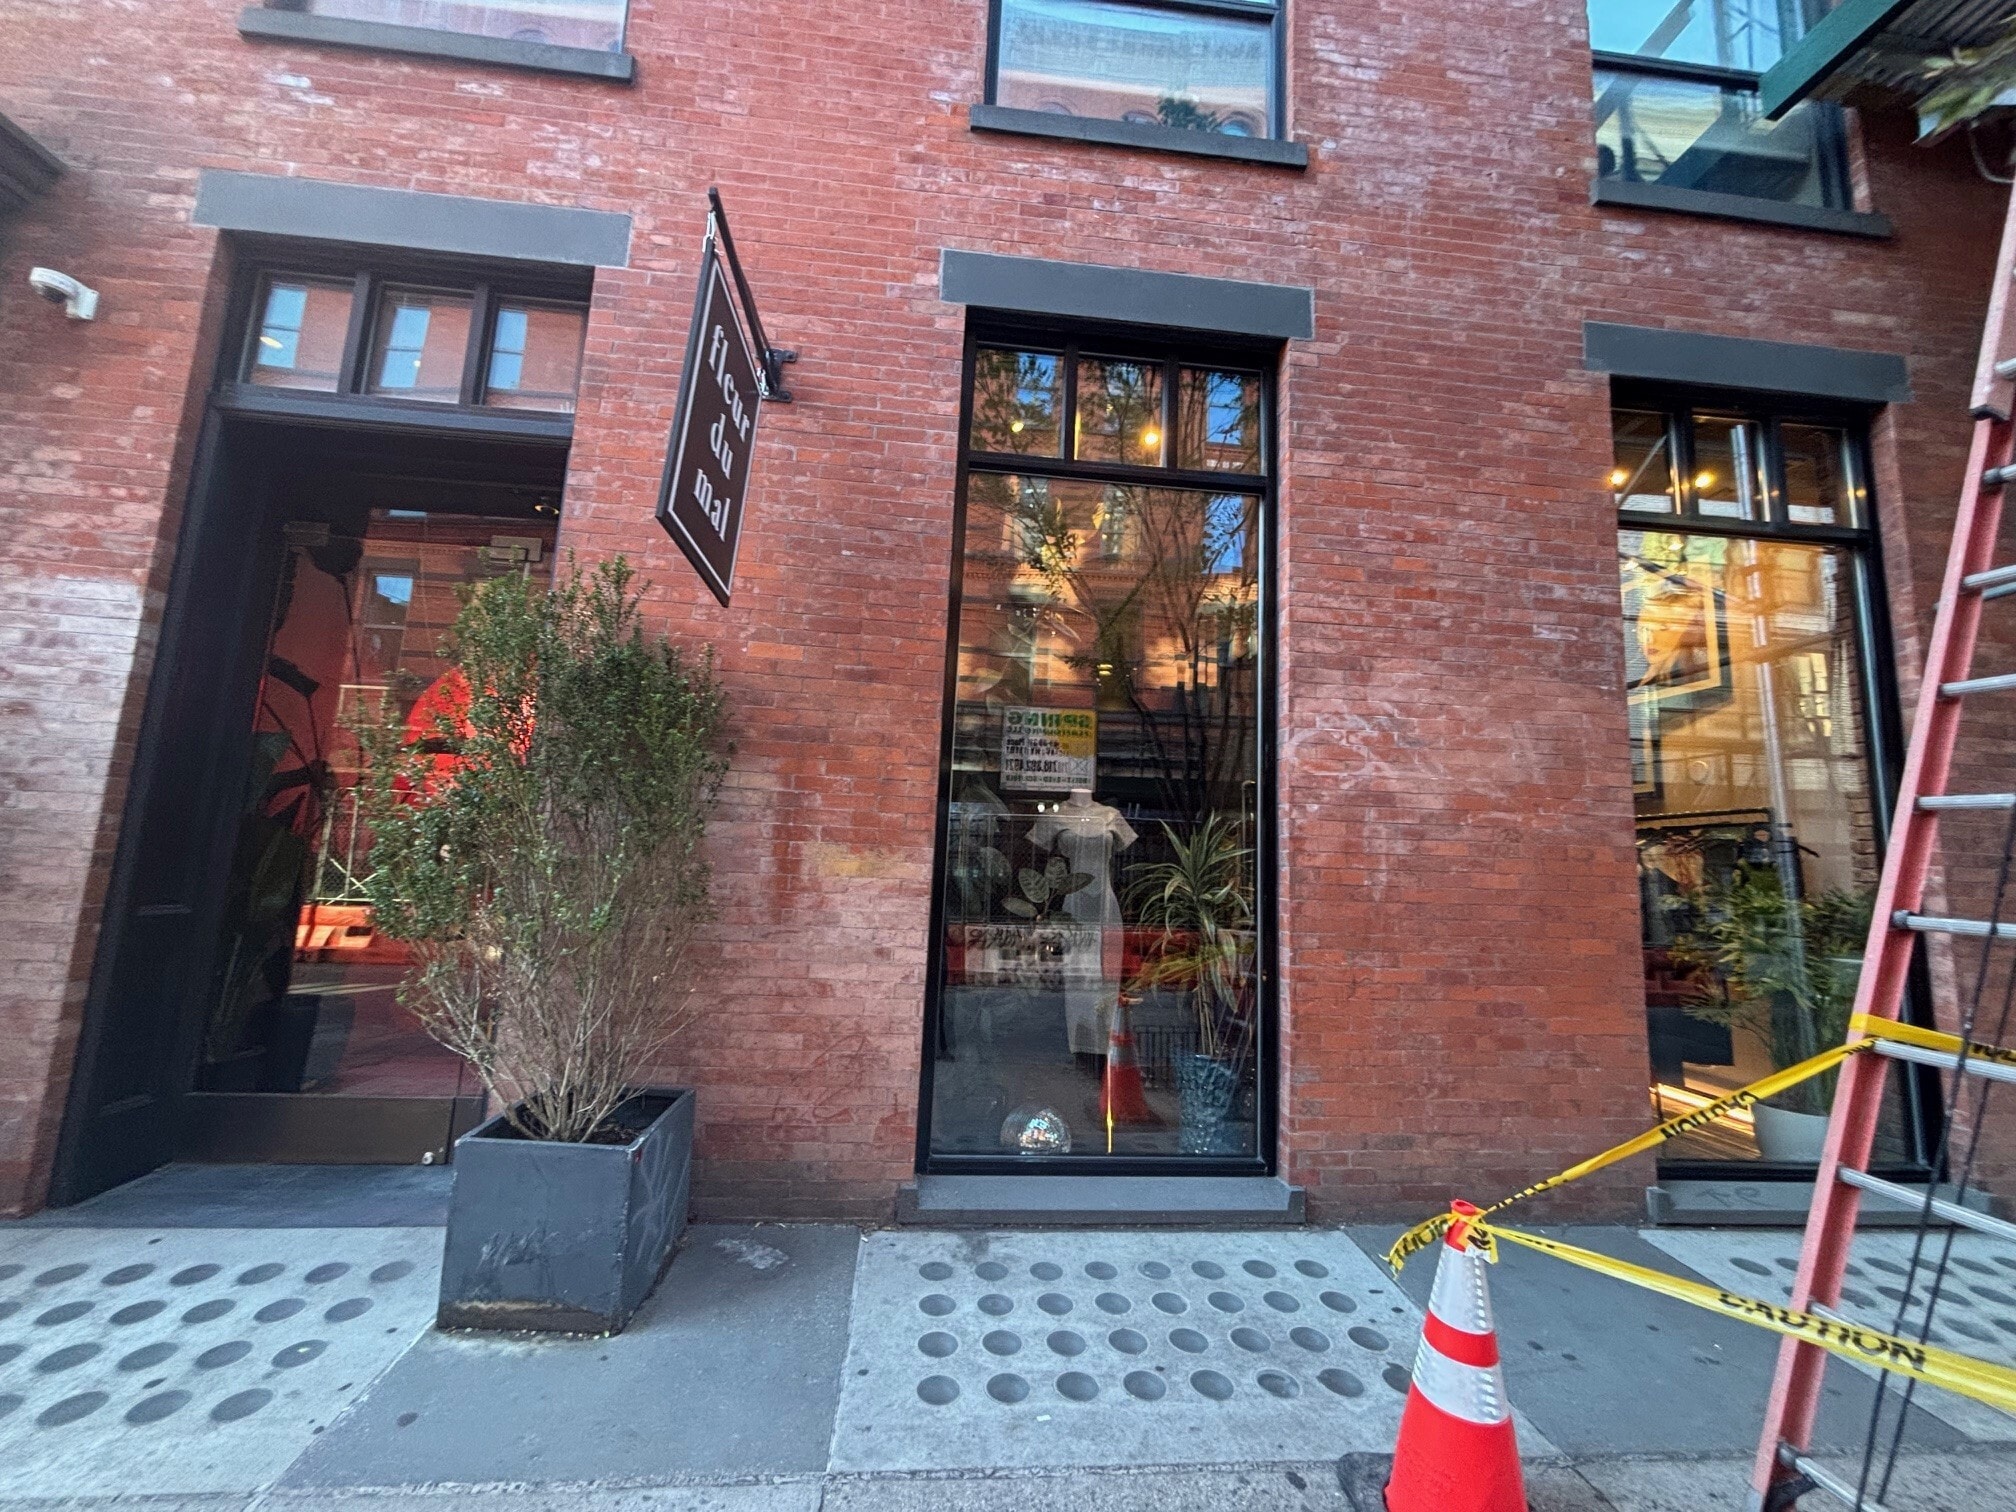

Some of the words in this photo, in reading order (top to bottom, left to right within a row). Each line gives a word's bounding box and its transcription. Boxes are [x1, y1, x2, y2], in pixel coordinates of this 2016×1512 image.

[708, 324, 750, 443] fleur
[710, 412, 734, 480] du
[693, 468, 731, 542] mal
[1718, 1293, 1926, 1373] CAUTION
